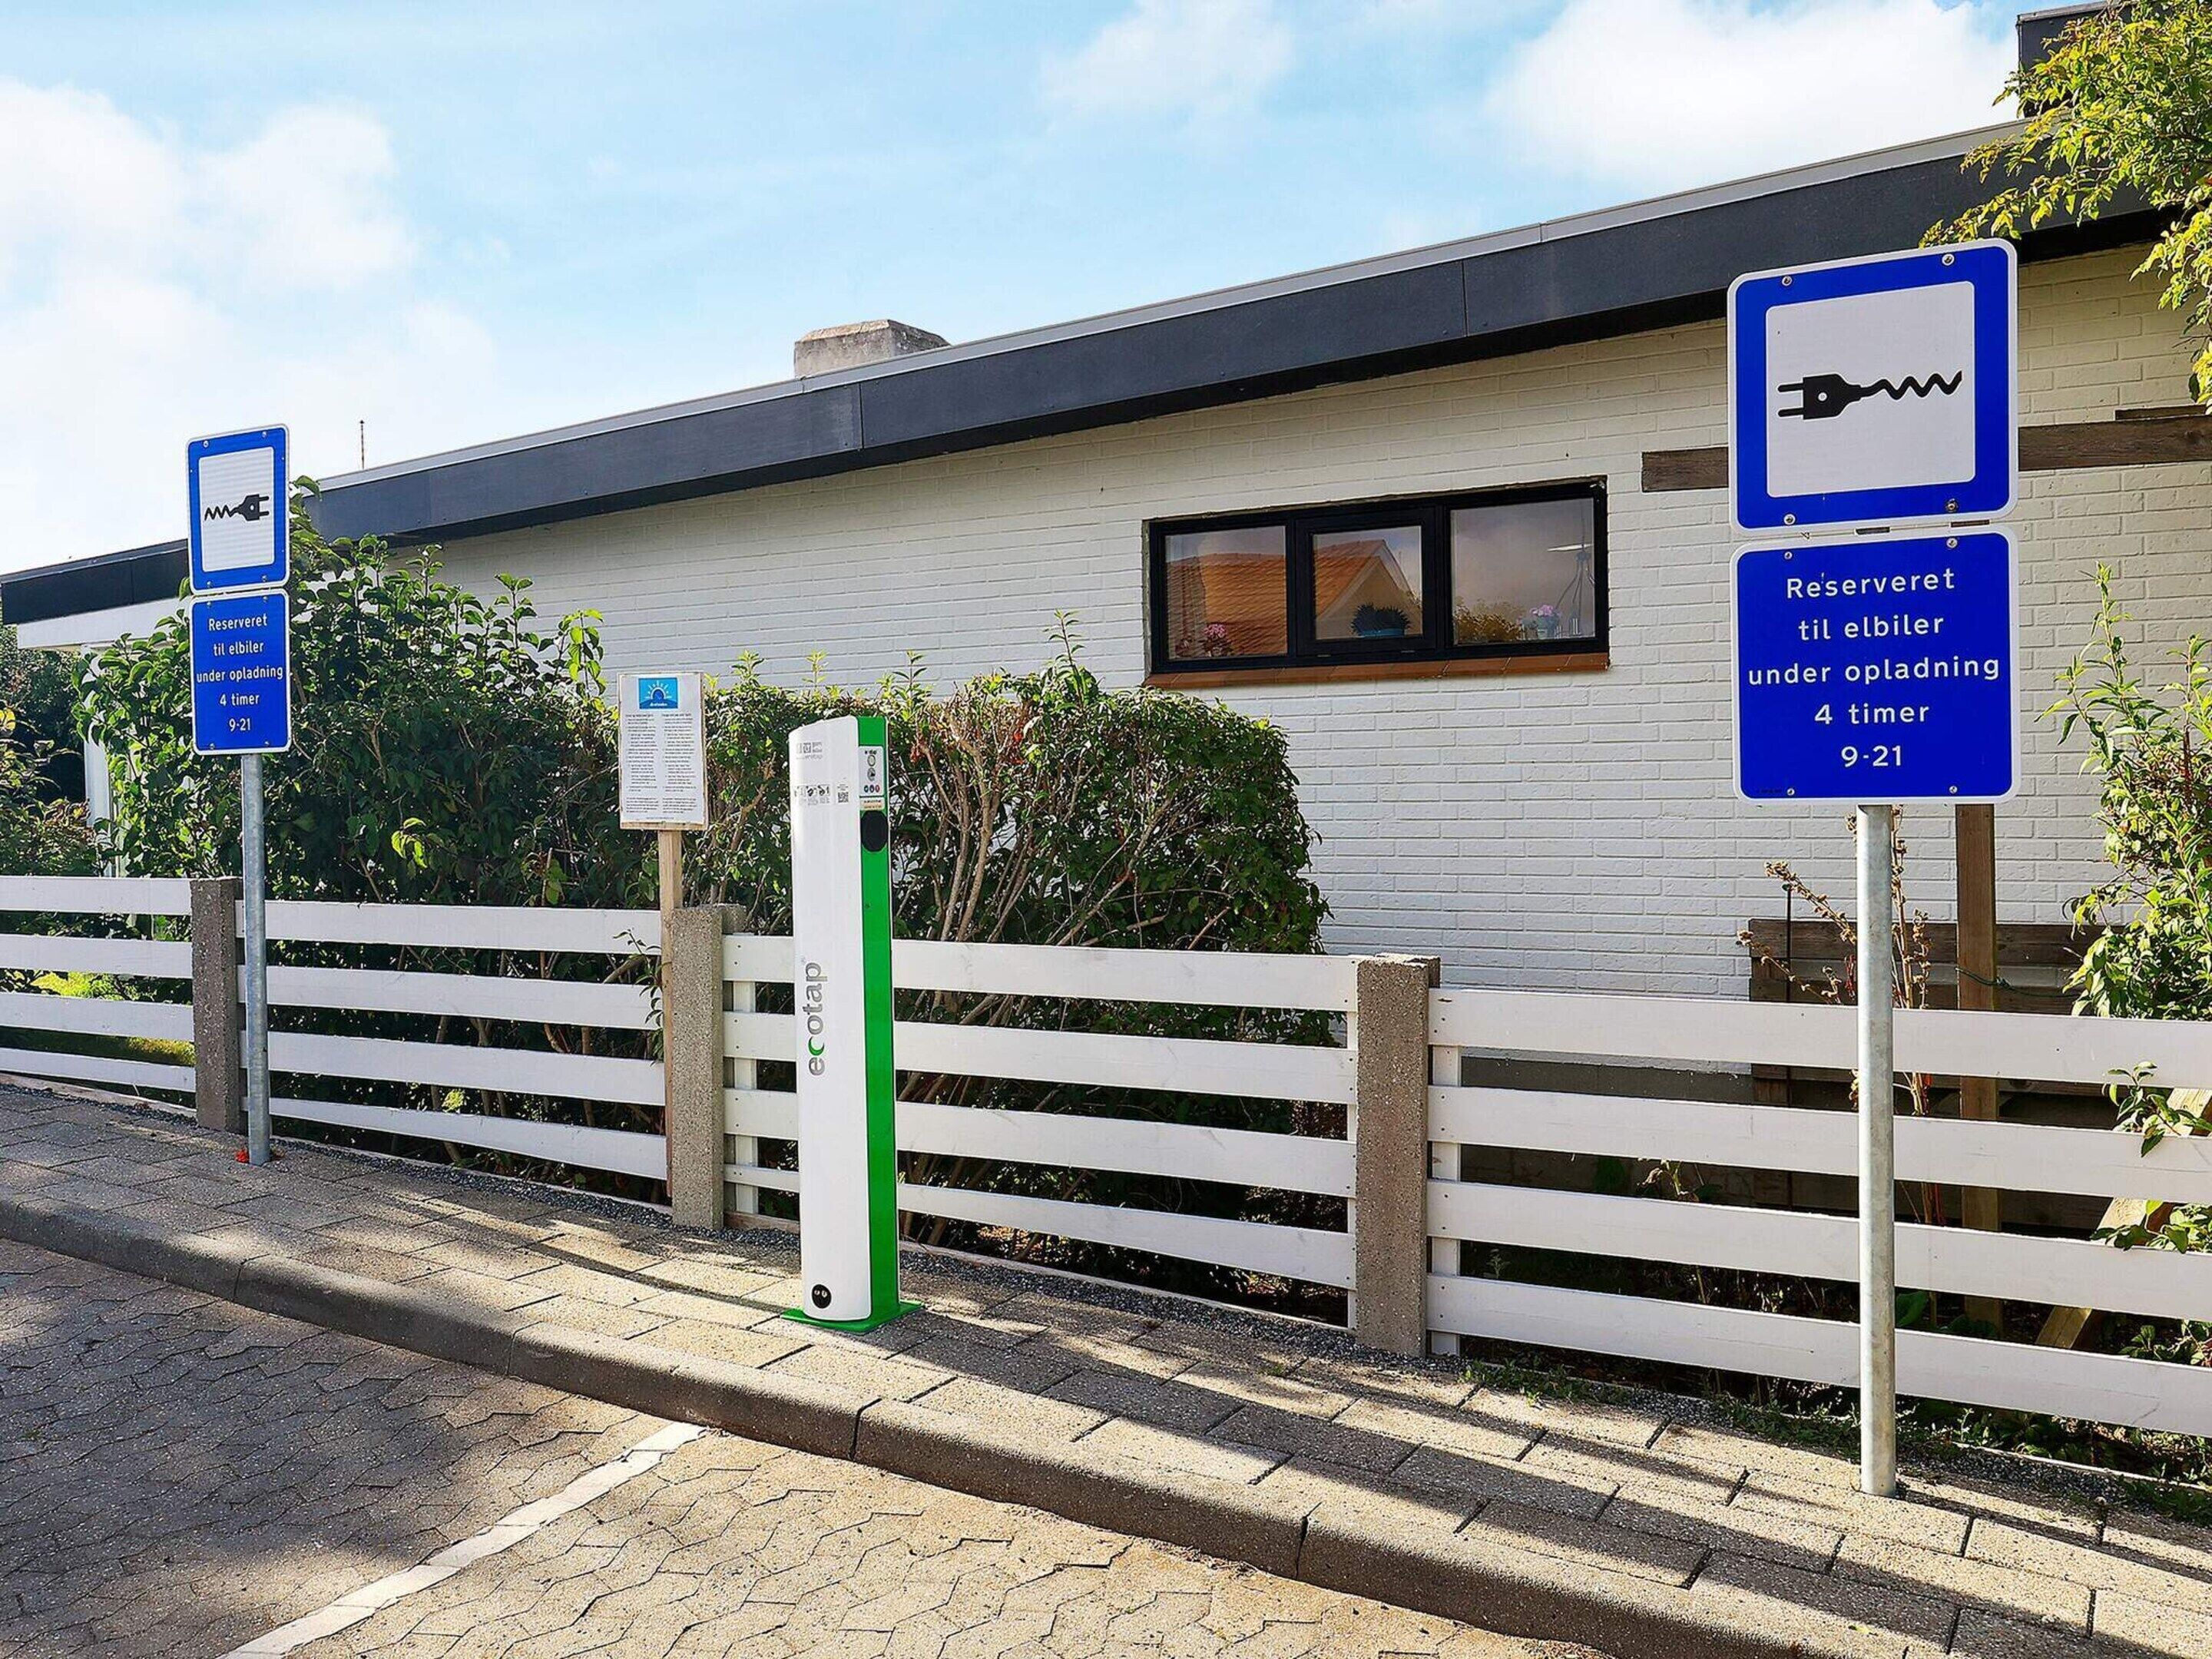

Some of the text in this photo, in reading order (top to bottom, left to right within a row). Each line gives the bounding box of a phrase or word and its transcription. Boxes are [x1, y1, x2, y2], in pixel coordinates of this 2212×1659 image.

[1786, 568, 1955, 599] Reserveret
[208, 613, 267, 631] Reserveret
[1798, 614, 1945, 641] til elbiler
[213, 641, 264, 657] til elbiler
[196, 666, 283, 683] under opladning
[1748, 656, 2000, 685] under opladning
[220, 693, 260, 707] 4 timer
[228, 718, 251, 732] 9-21
[1814, 703, 1930, 725] 4 timer
[1840, 744, 1902, 767] 9-21
[802, 962, 828, 1076] ecotap
